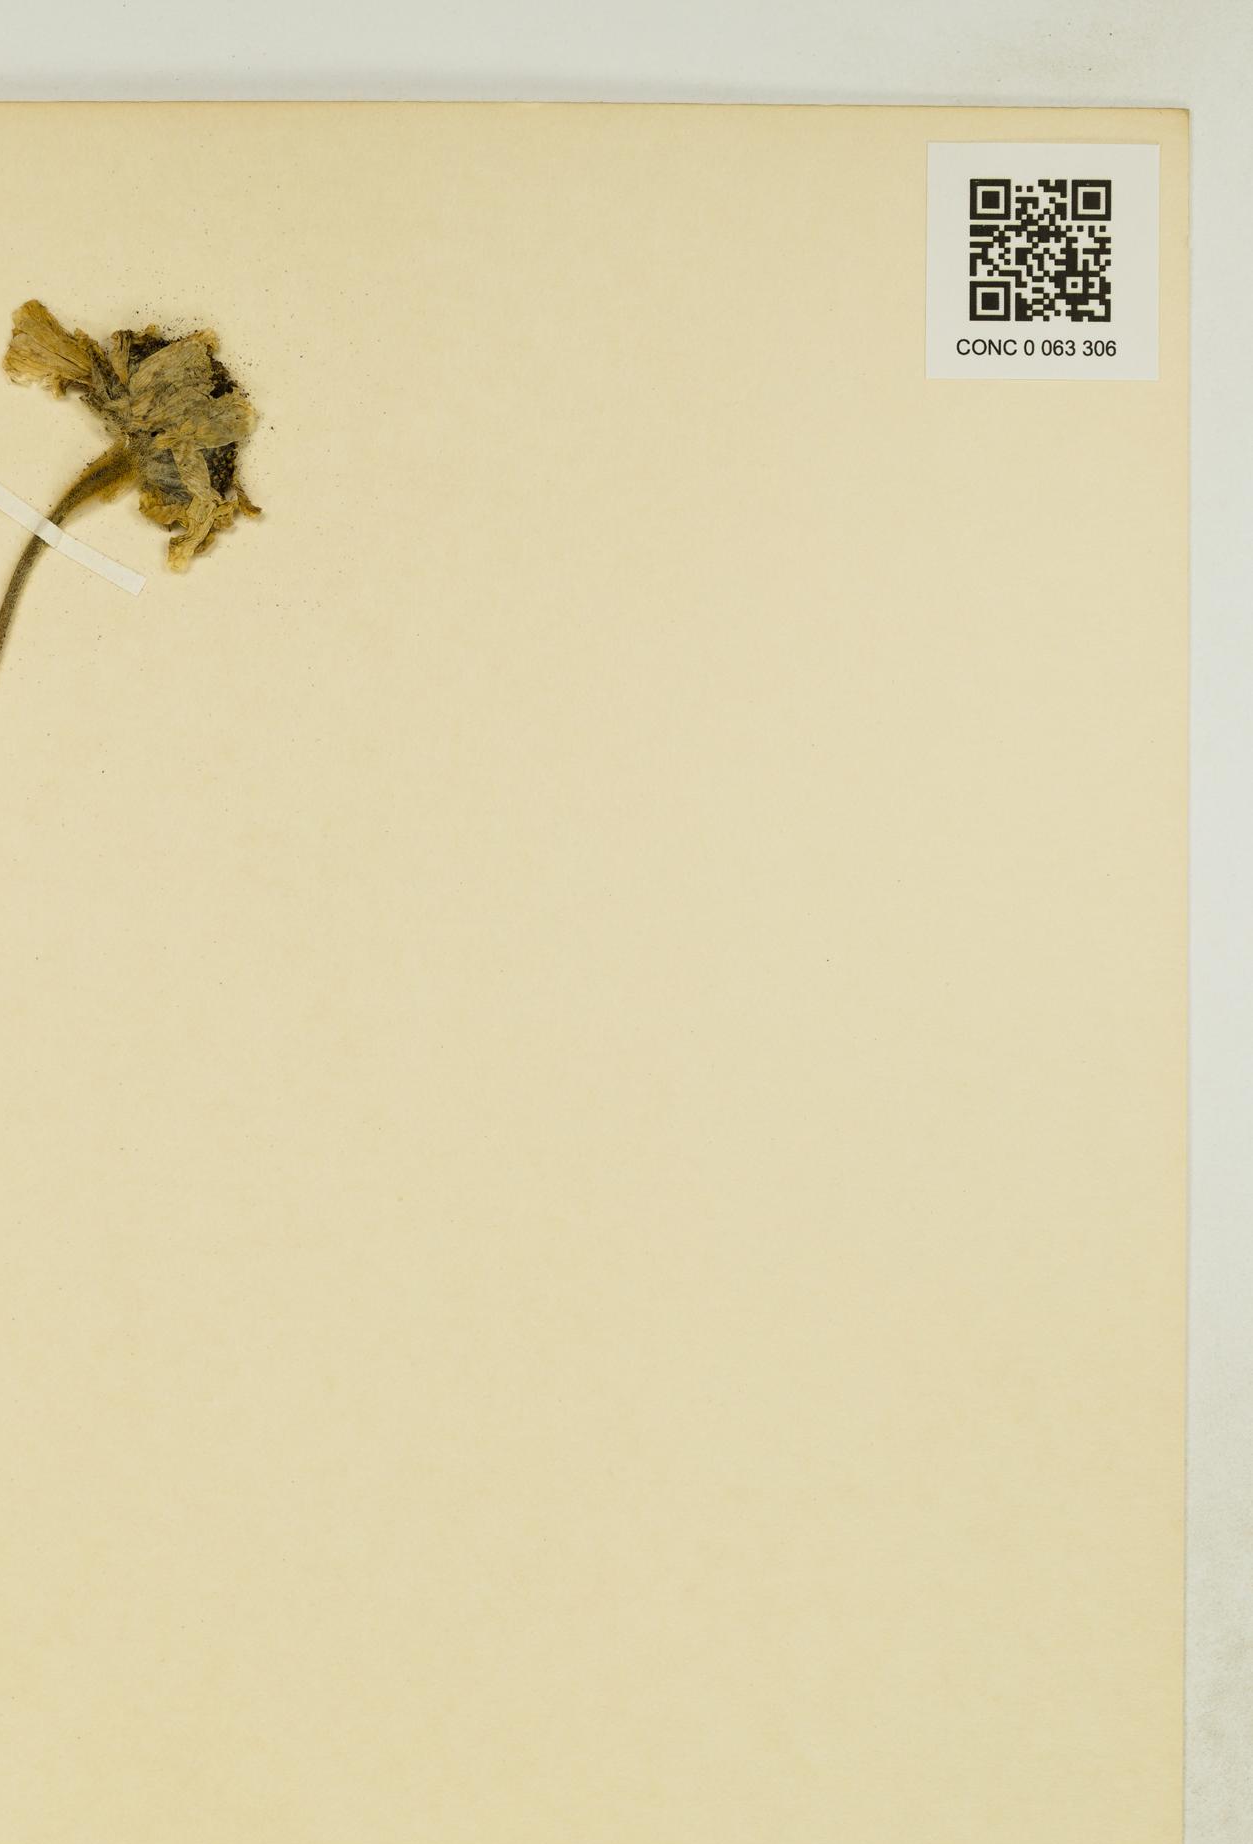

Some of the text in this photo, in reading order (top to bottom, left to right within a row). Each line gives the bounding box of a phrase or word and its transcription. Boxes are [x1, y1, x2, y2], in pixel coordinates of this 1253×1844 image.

[957, 339, 1116, 356] CONC 0 063 306
